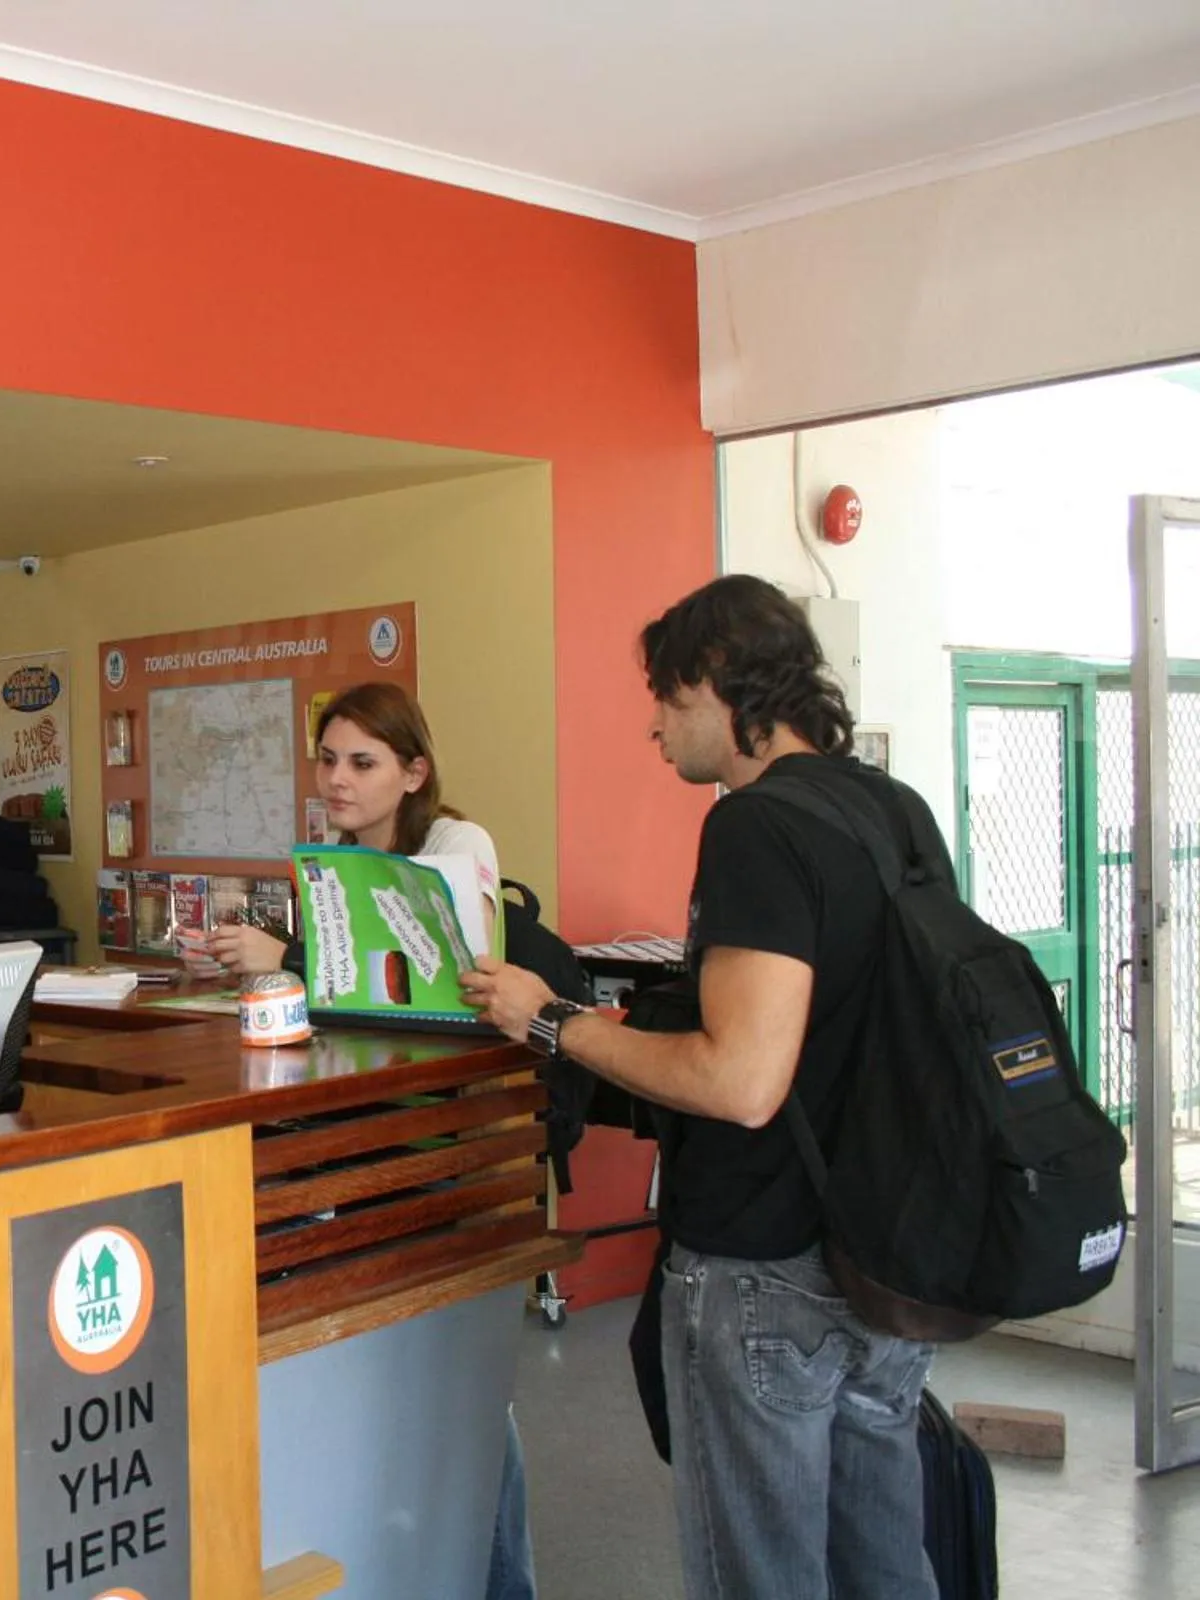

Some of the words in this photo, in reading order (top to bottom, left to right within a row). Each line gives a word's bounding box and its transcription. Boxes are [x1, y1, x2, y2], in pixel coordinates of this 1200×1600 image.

[144, 653, 180, 673] TOURS
[181, 651, 197, 668] IN
[198, 645, 252, 667] CENTRAL
[255, 637, 328, 661] AUSTRALIA
[339, 957, 350, 988] YHA
[77, 1302, 122, 1331] YHA
[77, 1324, 122, 1343] AUSTRALIA
[51, 1381, 154, 1453] JOIN
[59, 1448, 153, 1514] YHA
[46, 1508, 167, 1591] HERE
